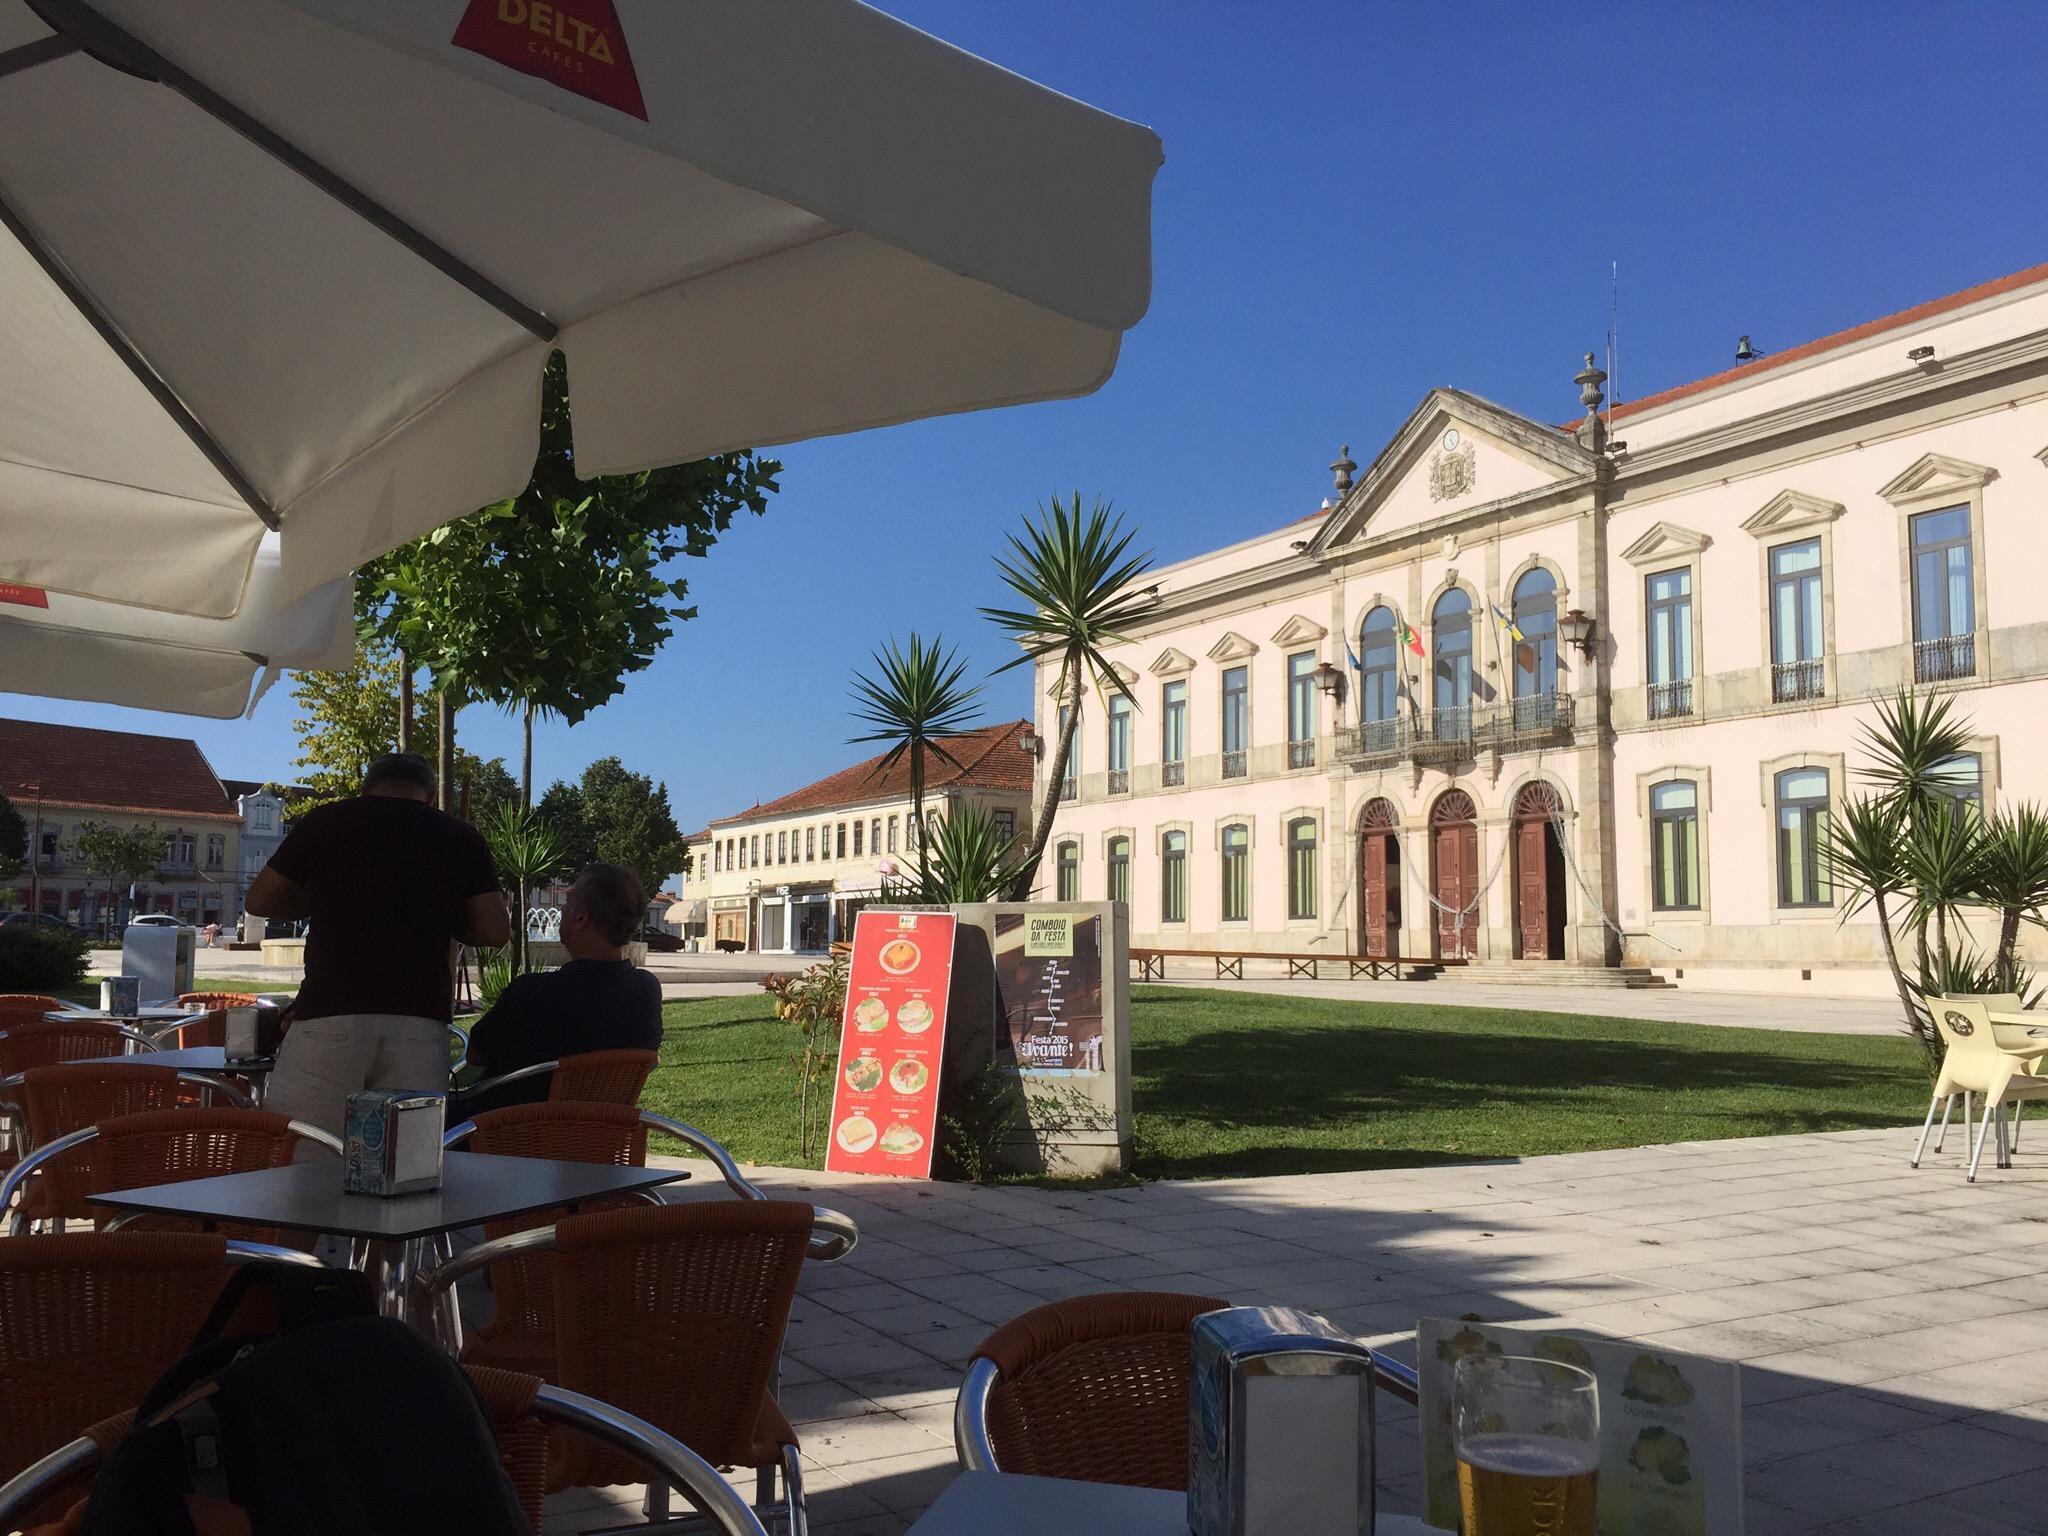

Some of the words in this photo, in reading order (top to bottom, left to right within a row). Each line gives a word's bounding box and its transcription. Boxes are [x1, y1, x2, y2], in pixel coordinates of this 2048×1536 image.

[498, 0, 616, 66] DELTA
[1031, 919, 1067, 930] COMBOIO
[1031, 931, 1041, 941] DA
[1044, 931, 1066, 941] FESTA
[1031, 1035, 1051, 1044] Festa
